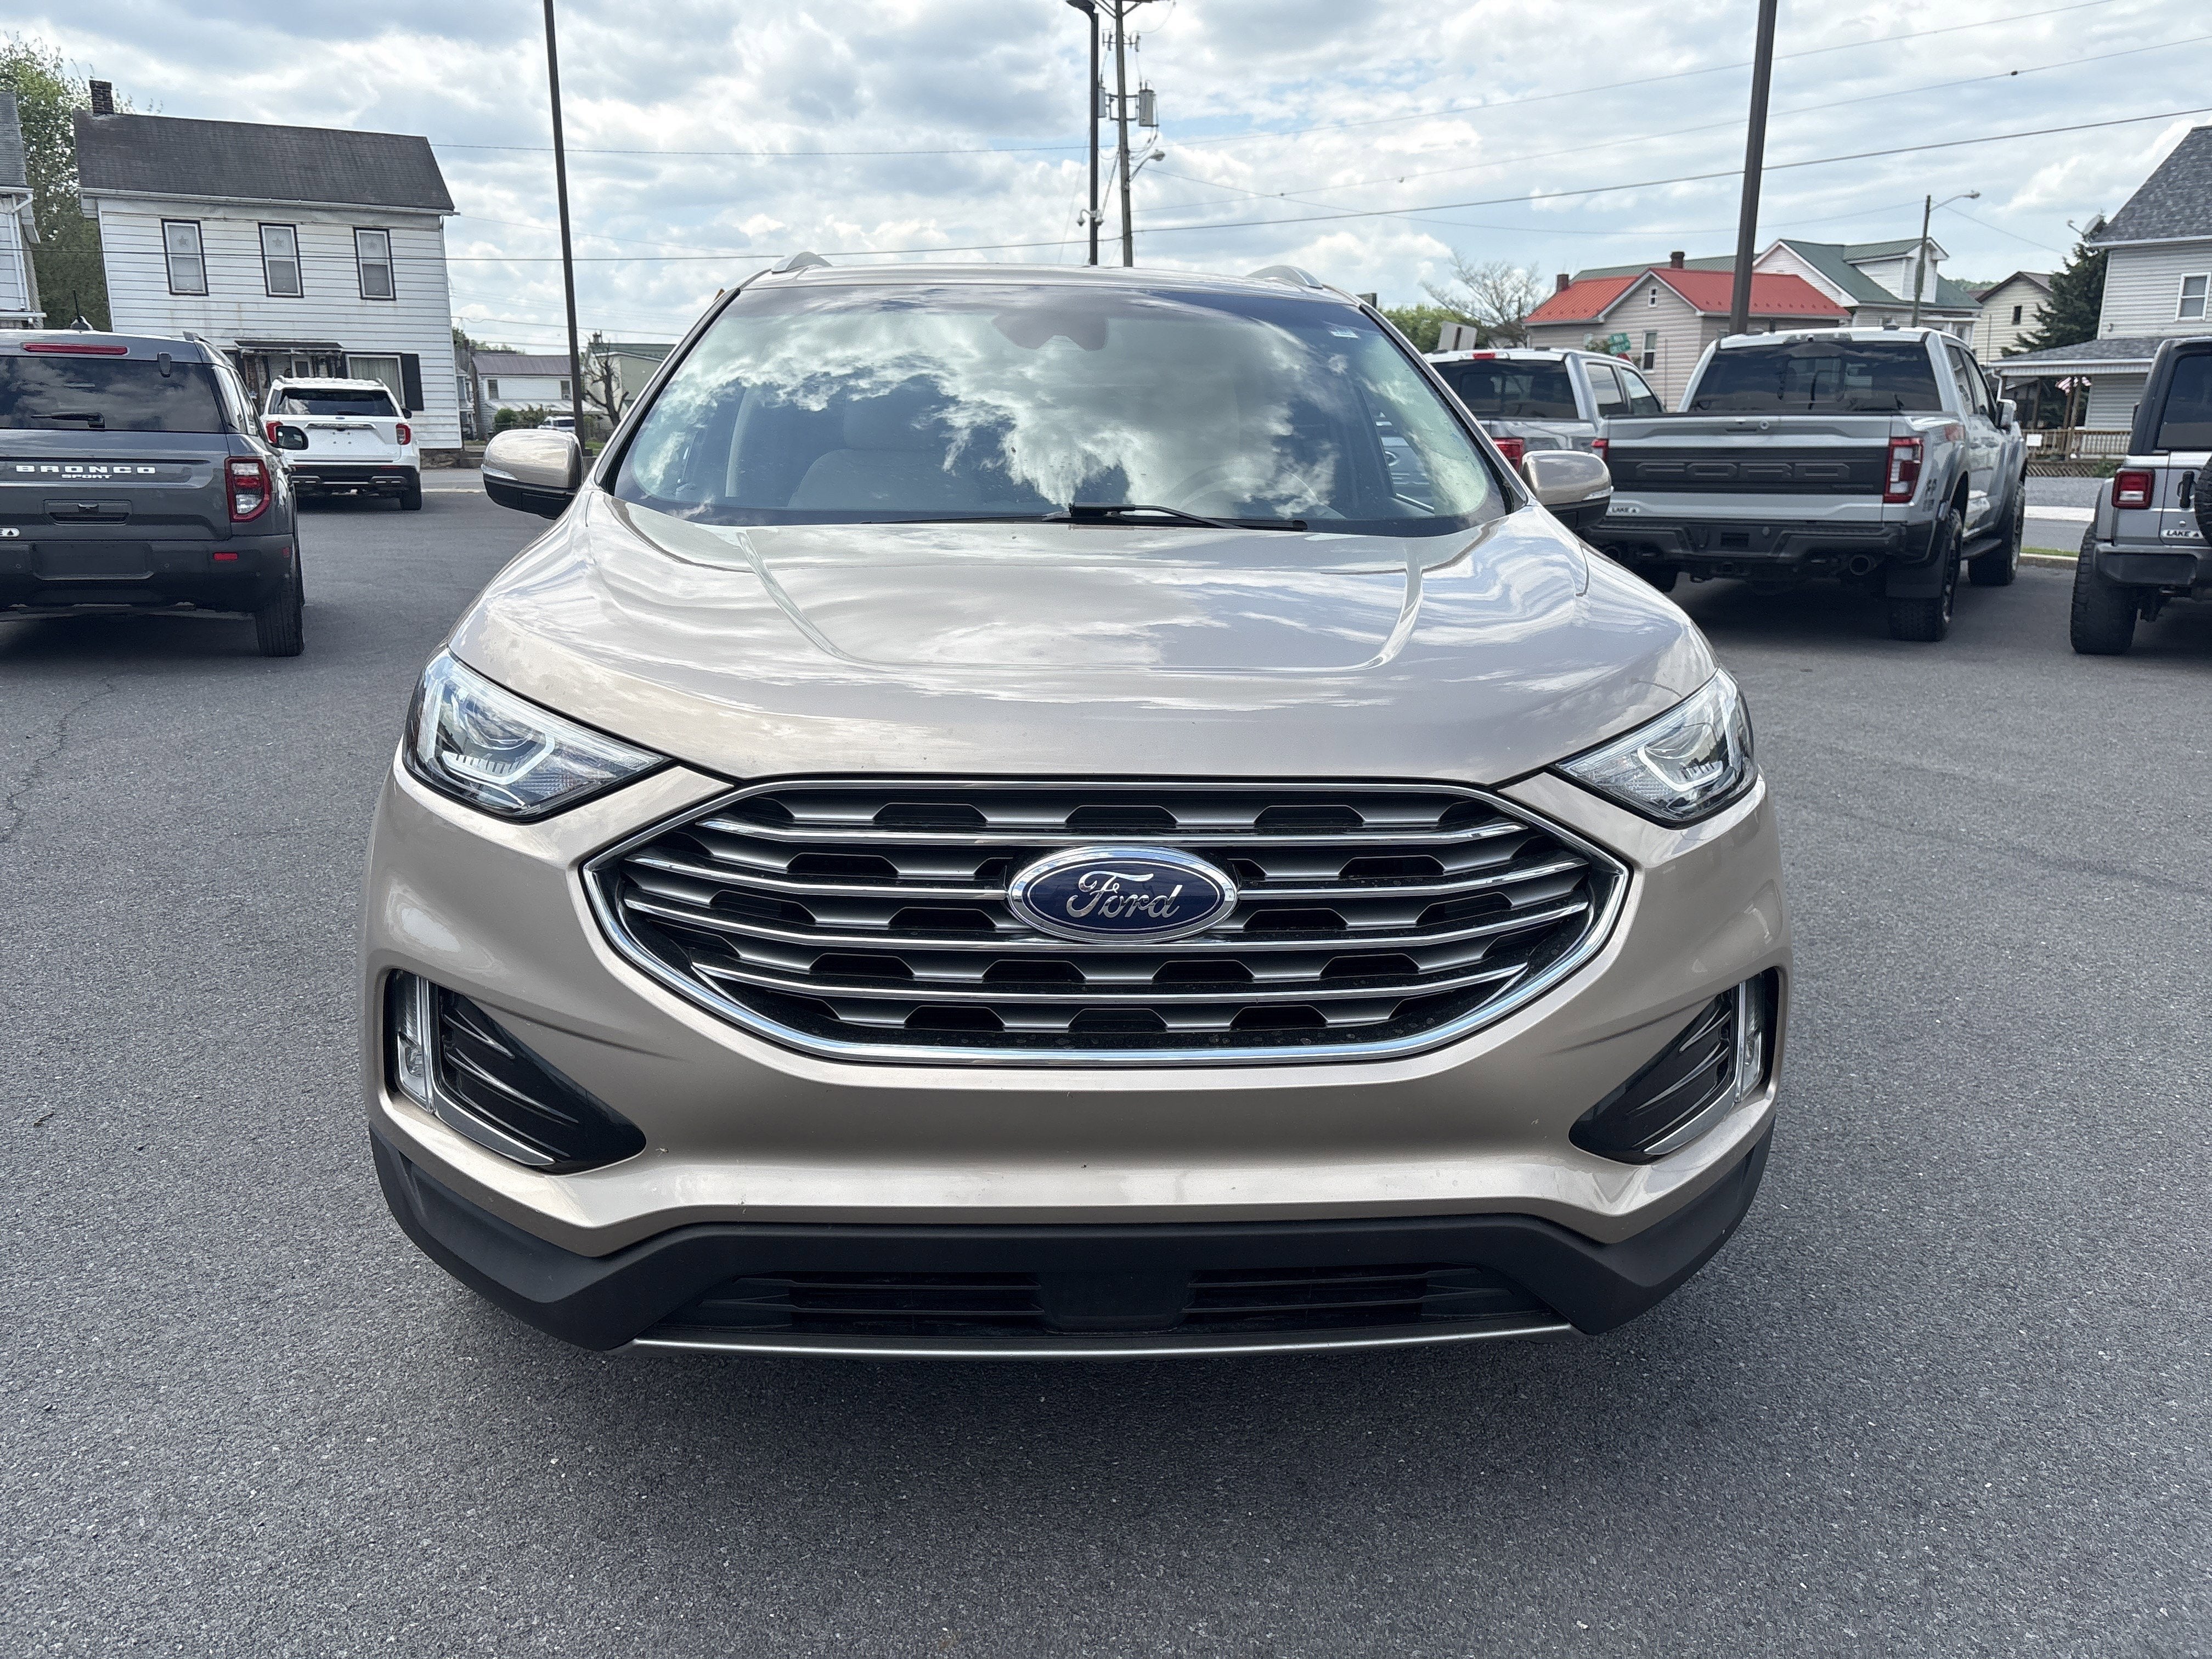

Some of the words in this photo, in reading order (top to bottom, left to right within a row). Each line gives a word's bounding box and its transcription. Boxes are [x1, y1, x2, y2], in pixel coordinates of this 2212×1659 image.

[16, 465, 156, 473] BRONCO
[1635, 462, 1850, 478] FORD
[1066, 870, 1183, 918] Ford
